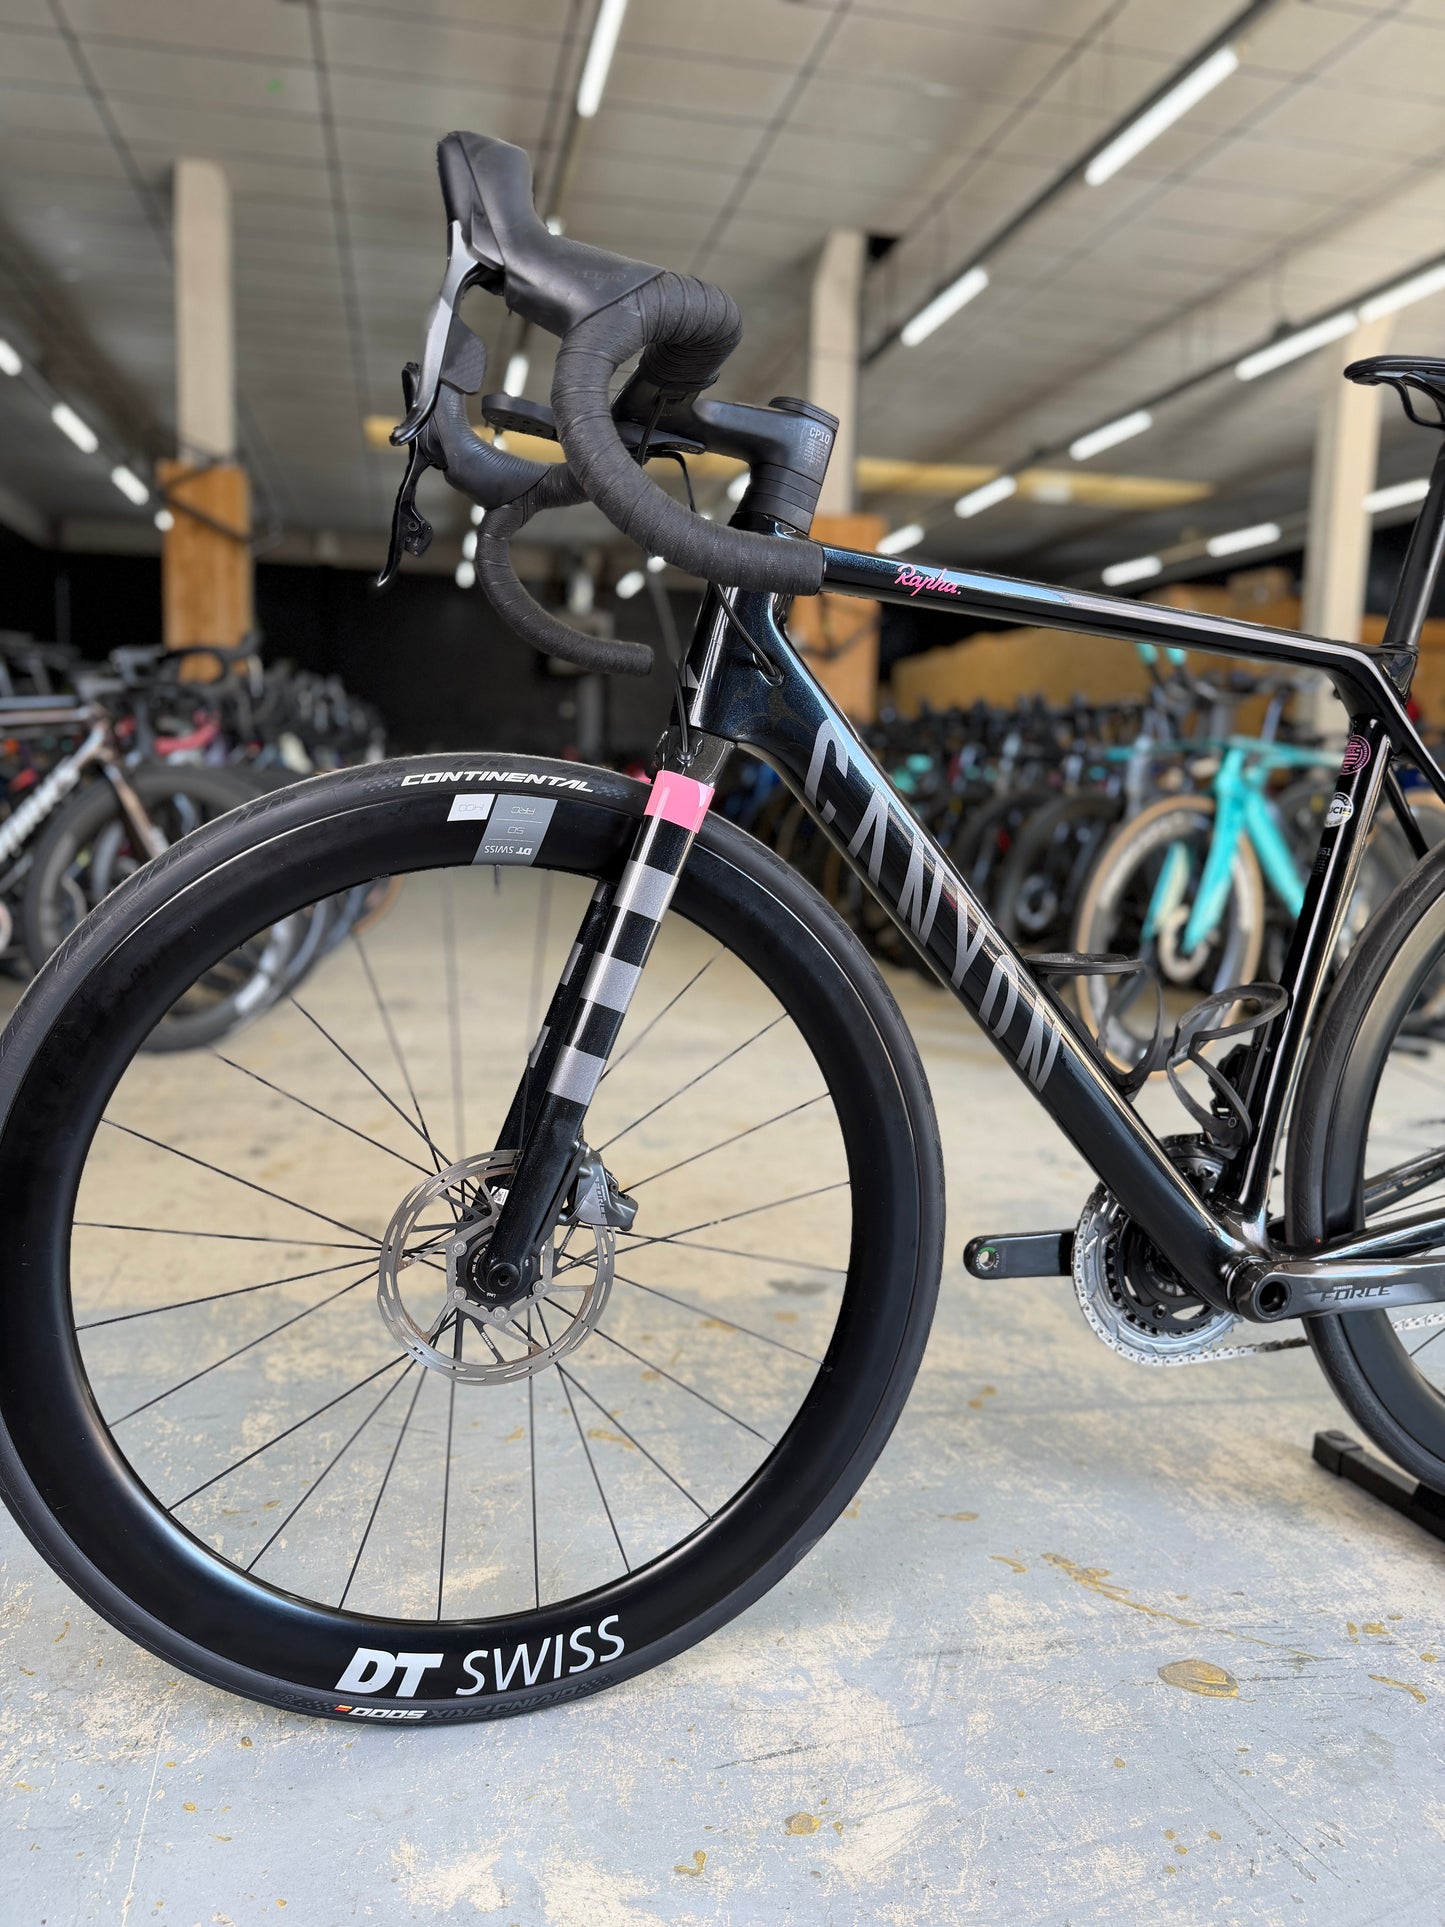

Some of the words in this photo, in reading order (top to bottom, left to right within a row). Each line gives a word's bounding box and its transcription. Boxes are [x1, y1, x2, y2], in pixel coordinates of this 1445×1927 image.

[809, 426, 831, 444] CP10
[401, 770, 594, 793] CONTINENTAL
[484, 845, 514, 854] SWISS
[516, 846, 533, 856] DT
[804, 718, 1063, 1092] CANYON
[1320, 1286, 1391, 1302] FORCE
[334, 1647, 444, 1697] DT
[456, 1614, 626, 1696] SWISS
[348, 1706, 427, 1720] 5000
